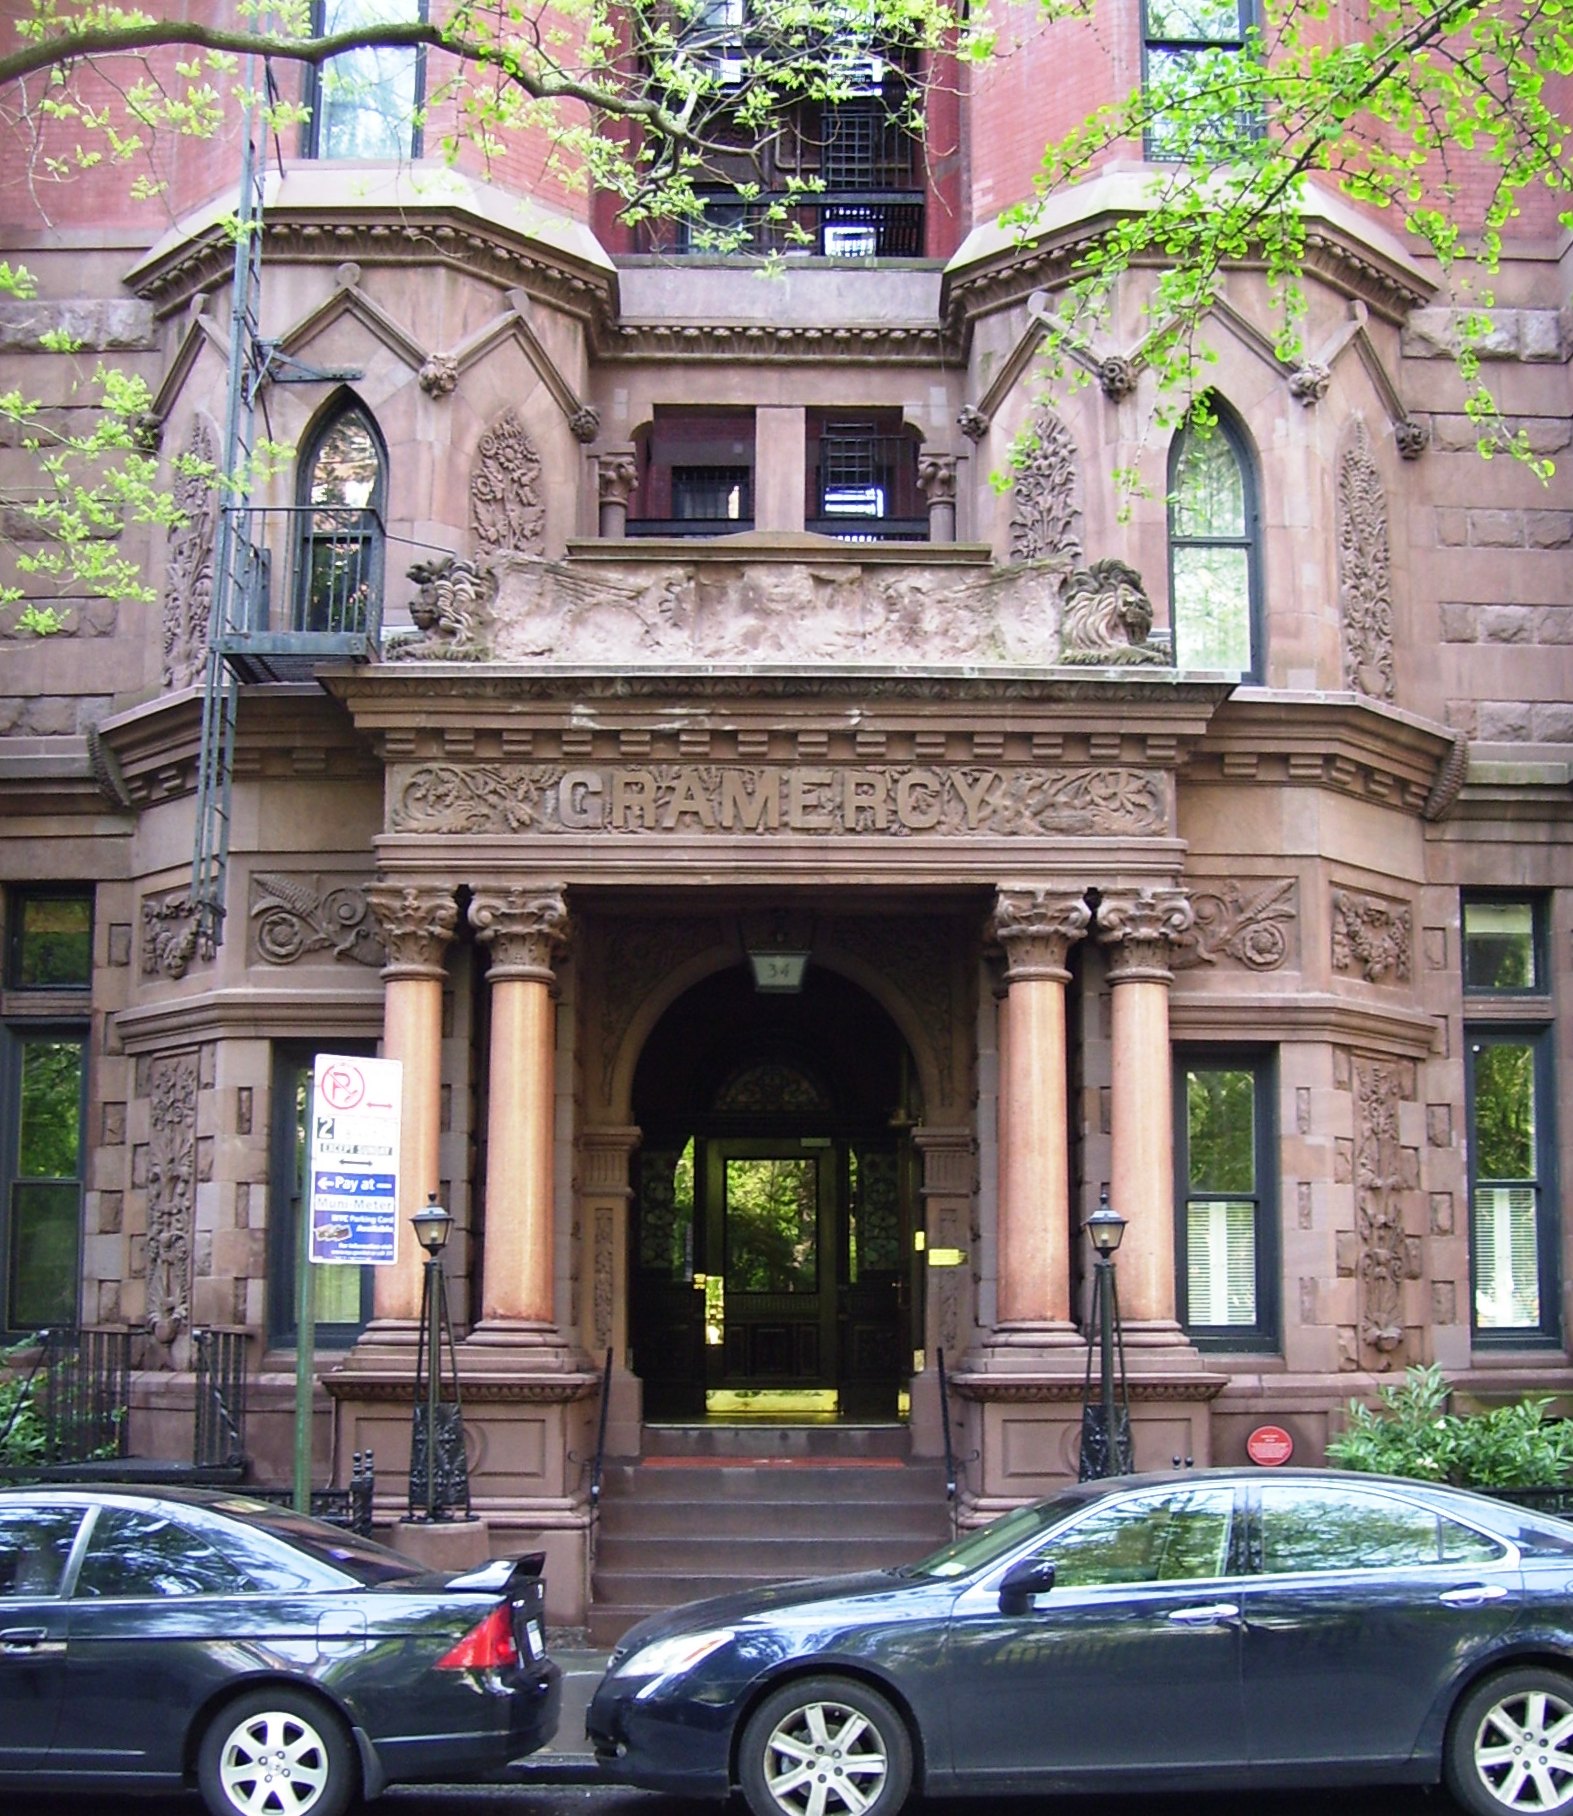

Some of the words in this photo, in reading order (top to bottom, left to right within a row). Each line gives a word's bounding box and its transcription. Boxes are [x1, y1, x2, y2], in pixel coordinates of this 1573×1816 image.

[558, 769, 1003, 830] GRAMERCY
[768, 962, 791, 979] 34
[318, 1117, 334, 1139] 2
[334, 1175, 358, 1193] Pay
[360, 1178, 376, 1191] at
